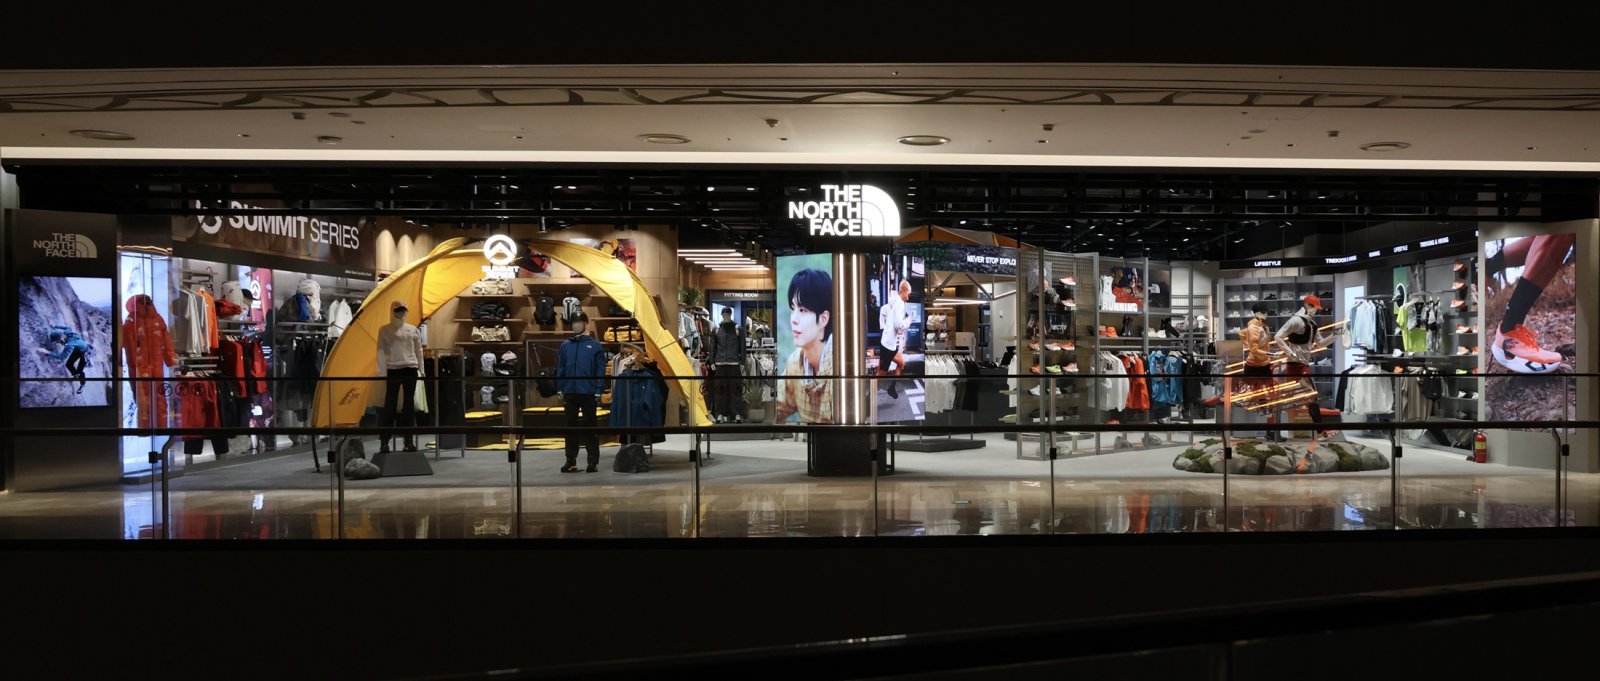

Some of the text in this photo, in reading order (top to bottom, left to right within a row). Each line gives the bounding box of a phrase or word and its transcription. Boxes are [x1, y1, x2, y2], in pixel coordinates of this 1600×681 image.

[821, 185, 861, 202] THE
[789, 201, 861, 219] NORTH
[229, 200, 360, 250] SUMMIT SERIES
[810, 218, 861, 236] FACE
[52, 233, 75, 242] THE
[33, 240, 75, 250] NORTH
[46, 249, 75, 258] FACE
[967, 255, 984, 263] NEVER
[985, 256, 998, 264] STOP
[1102, 301, 1138, 312] RUNNING
